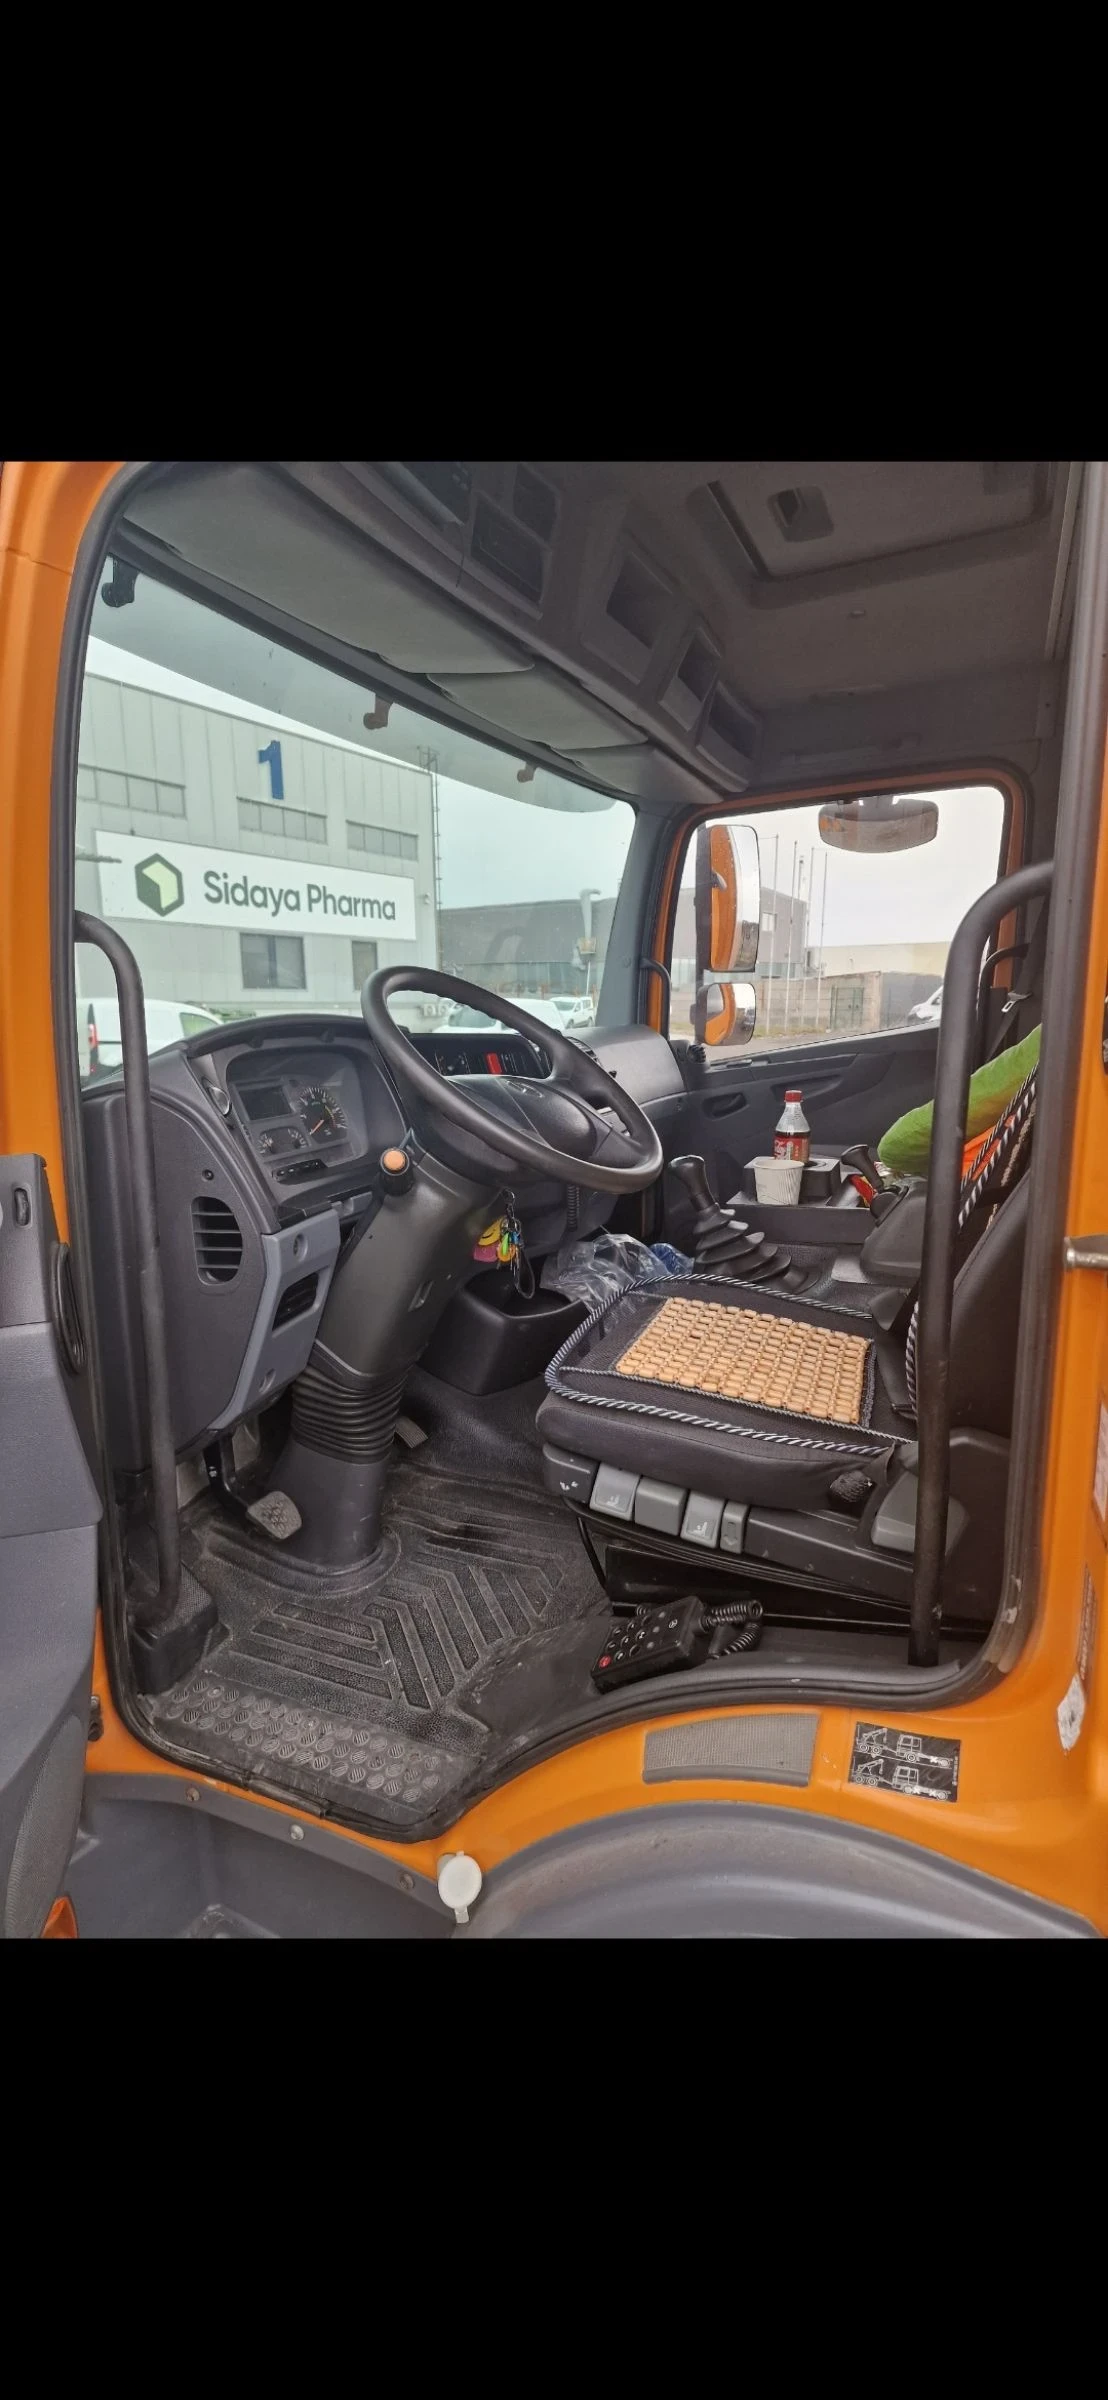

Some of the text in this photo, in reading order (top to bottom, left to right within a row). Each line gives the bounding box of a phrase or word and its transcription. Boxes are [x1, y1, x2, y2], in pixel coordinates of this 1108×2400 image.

[258, 740, 284, 800] 1
[203, 870, 396, 920] Sidaya Pharma
